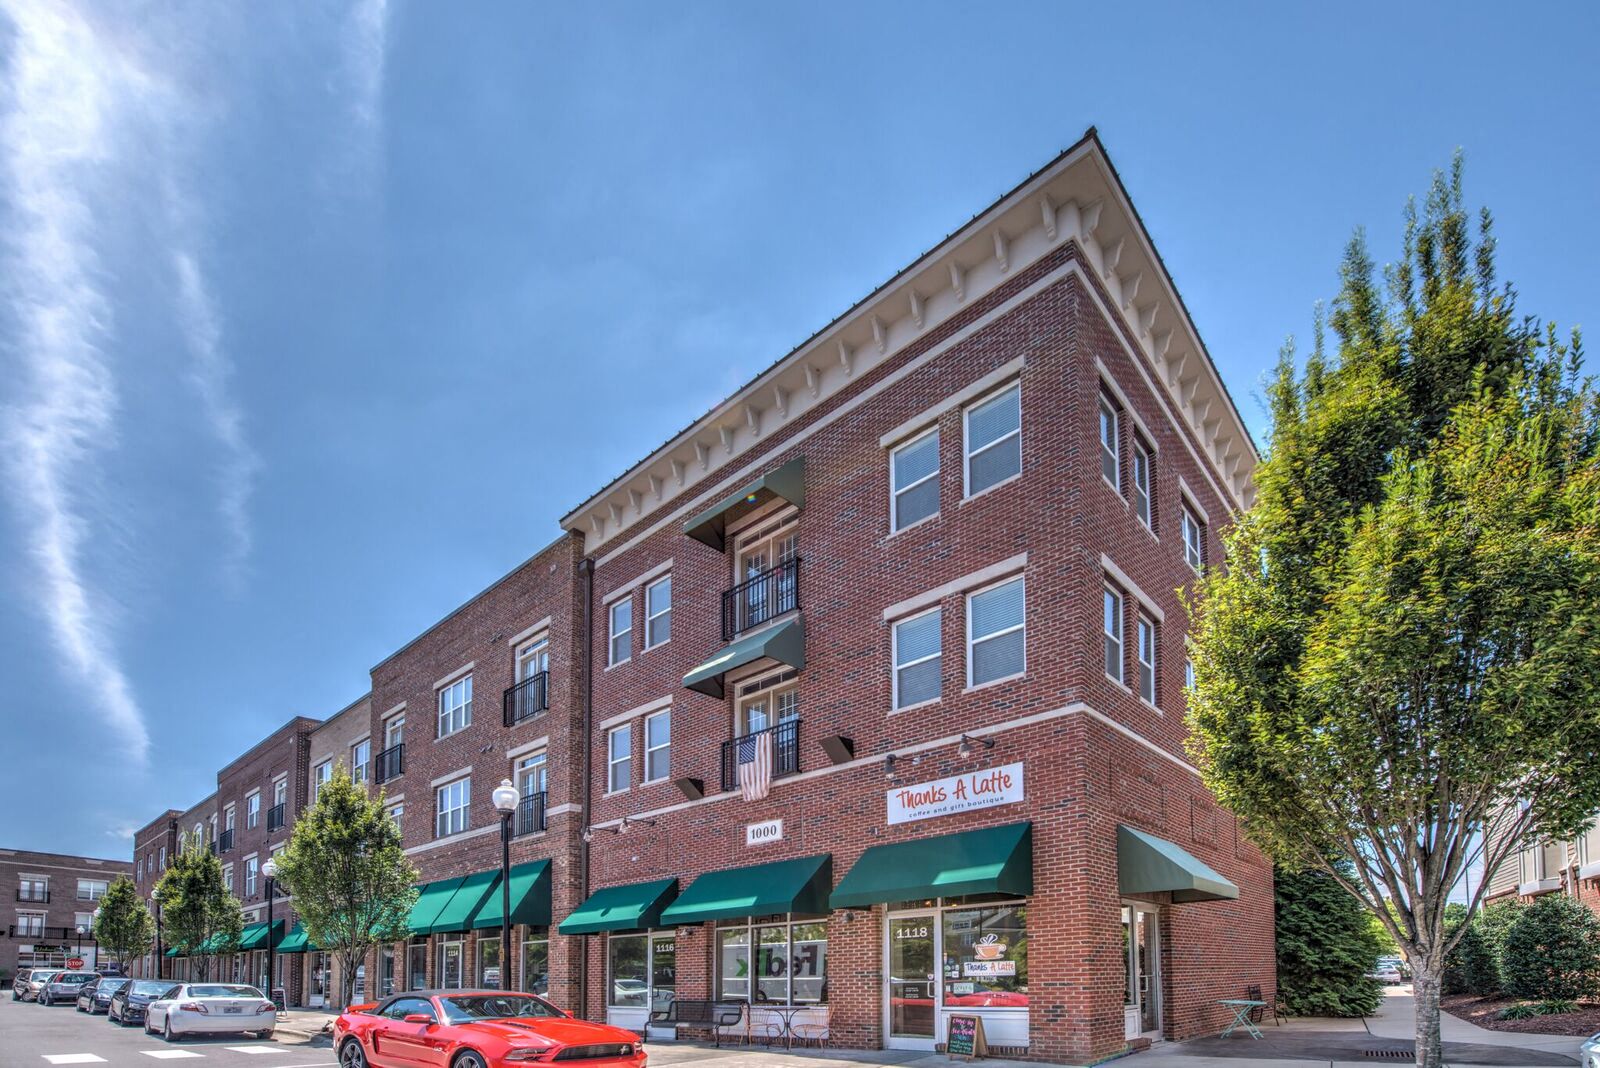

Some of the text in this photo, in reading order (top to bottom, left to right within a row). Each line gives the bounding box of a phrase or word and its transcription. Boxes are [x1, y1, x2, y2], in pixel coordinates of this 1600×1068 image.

[896, 770, 1012, 809] Thanks A Latte
[909, 796, 1004, 818] coffee and gift boutique
[751, 825, 777, 839] 1000
[896, 927, 928, 939] 1118
[656, 943, 675, 953] 1116
[966, 961, 1014, 972] Thanks A Latte
